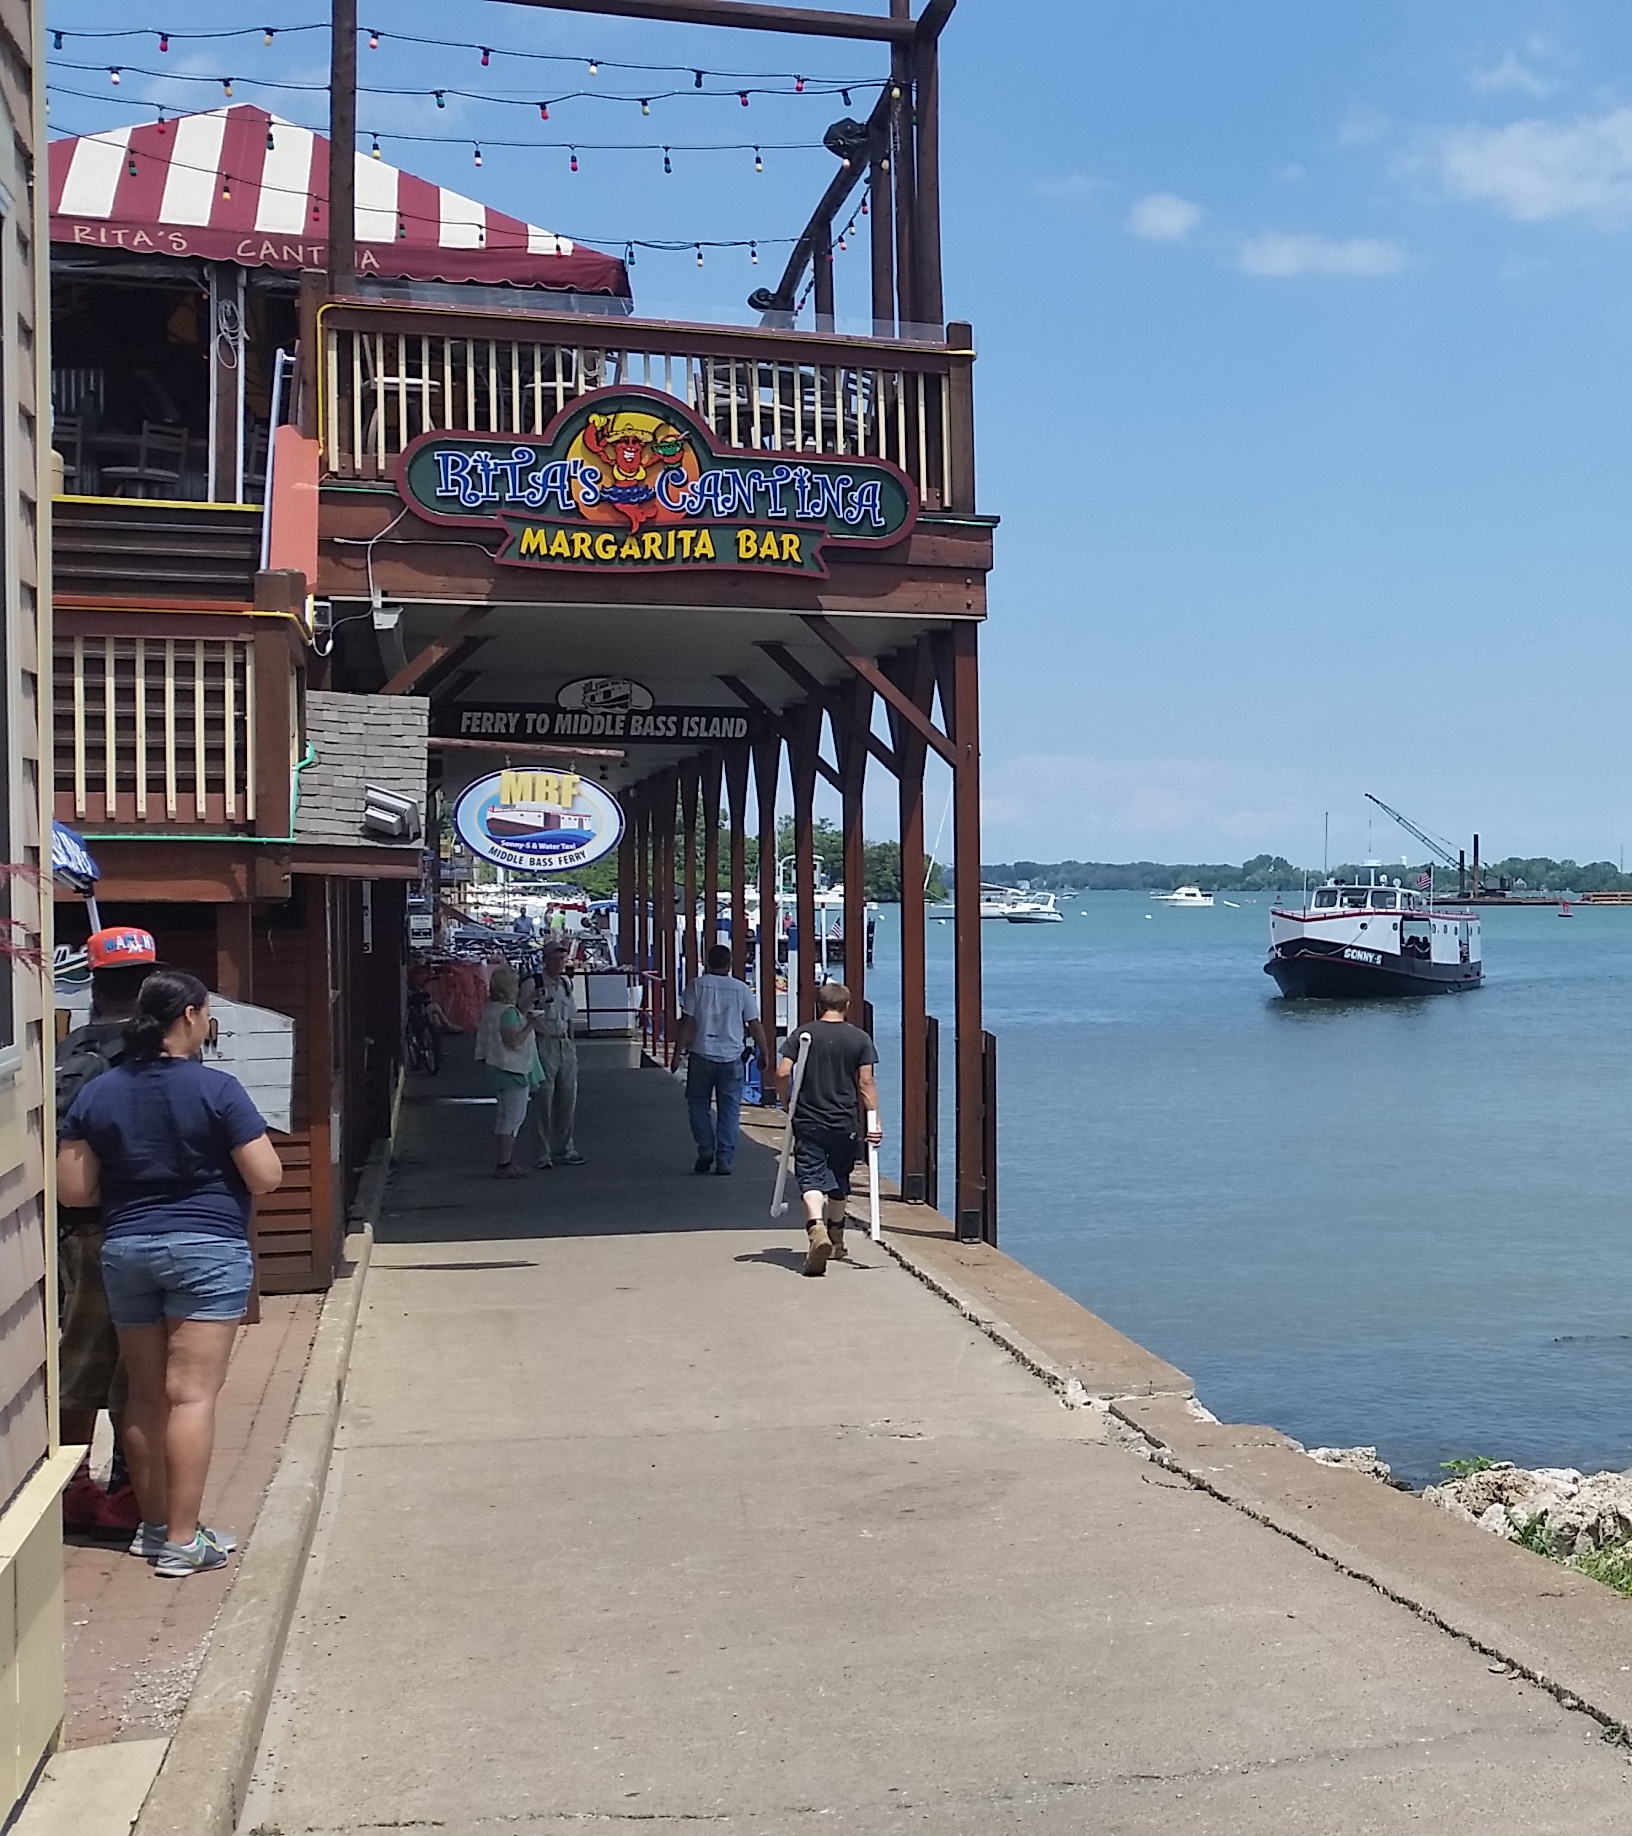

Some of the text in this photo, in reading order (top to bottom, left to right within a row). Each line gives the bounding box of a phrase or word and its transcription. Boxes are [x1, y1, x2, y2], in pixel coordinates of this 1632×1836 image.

[73, 225, 380, 269] RITA'S CANTA
[656, 465, 886, 528] CANTINA
[519, 527, 803, 563] MARGARITA BAR
[461, 712, 747, 738] FERRY TO MIDDLE BASS ISLAND
[500, 770, 580, 808] MBF
[488, 847, 586, 866] MIDDLE BASS FERRY
[500, 840, 531, 849] Sonny-S
